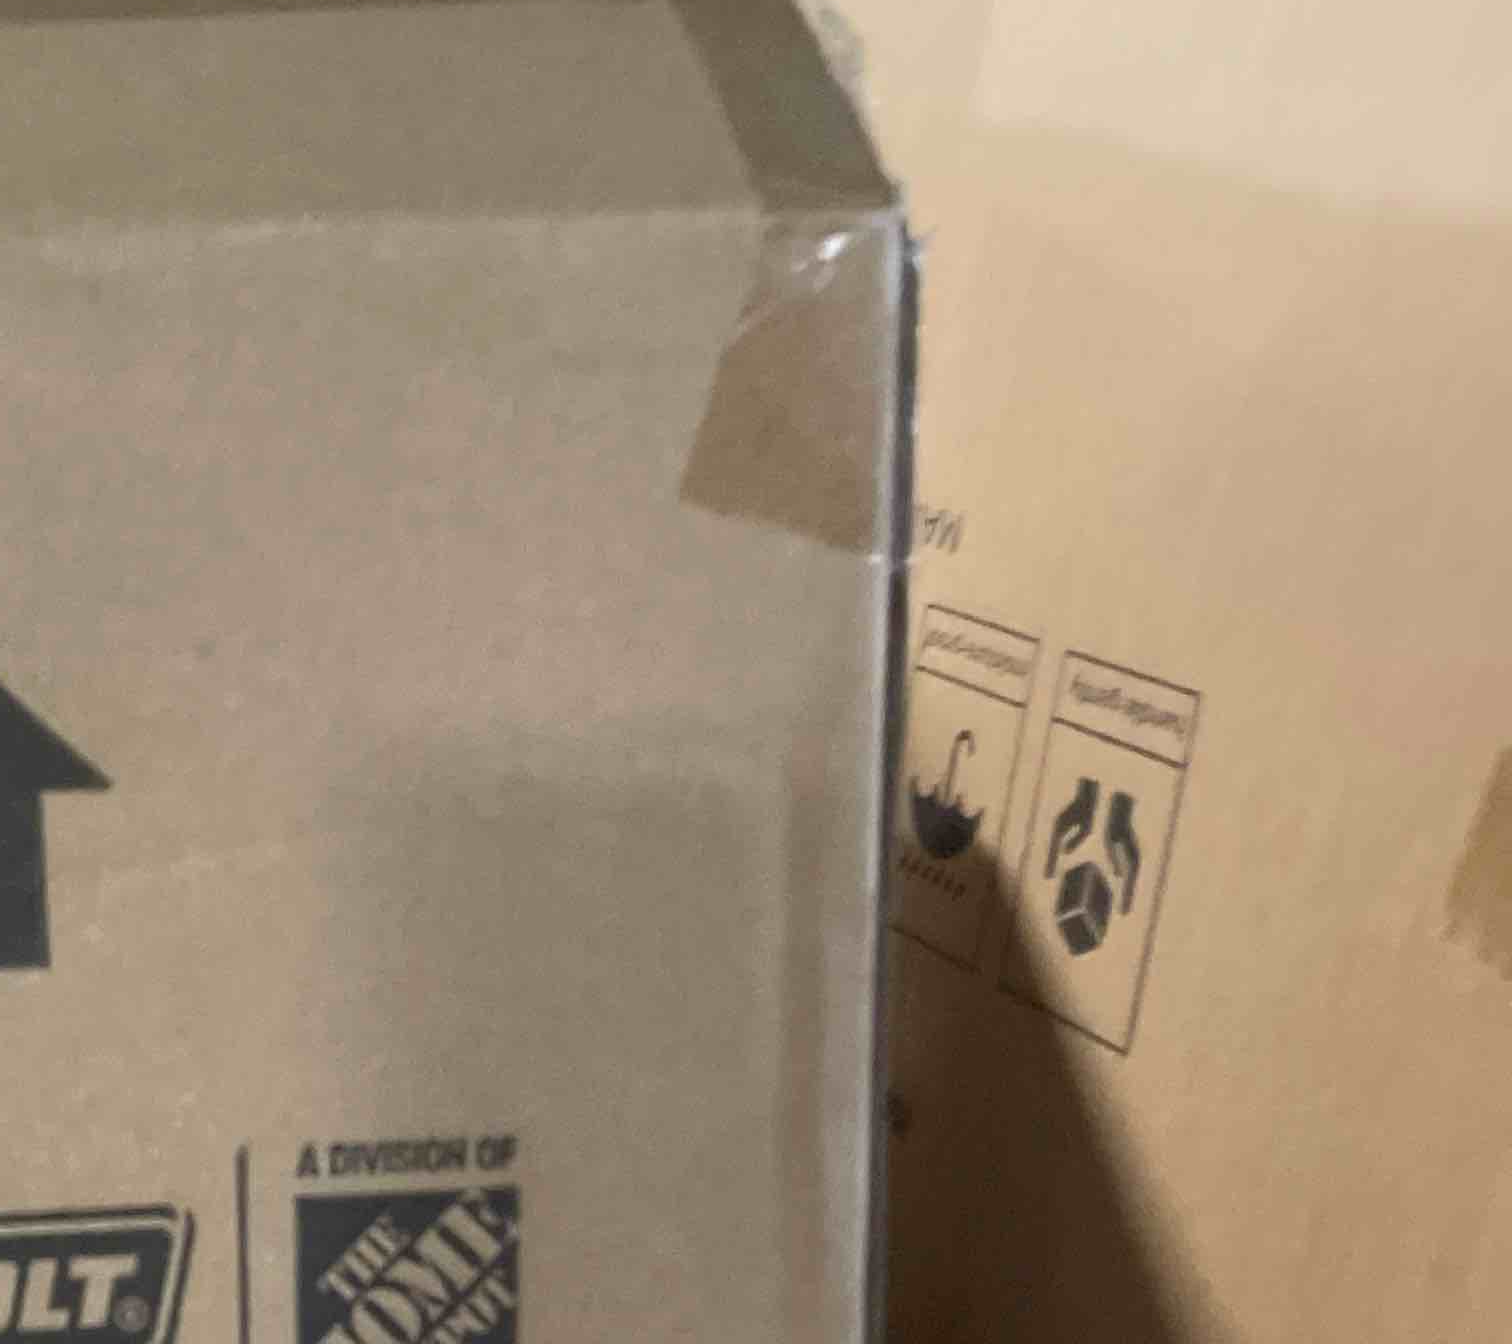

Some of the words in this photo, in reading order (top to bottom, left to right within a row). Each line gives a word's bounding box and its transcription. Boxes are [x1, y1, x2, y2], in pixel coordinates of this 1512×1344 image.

[296, 1141, 320, 1178] A
[328, 1136, 467, 1176] DIVISION
[475, 1134, 518, 1172] OF
[316, 1212, 414, 1300] THE
